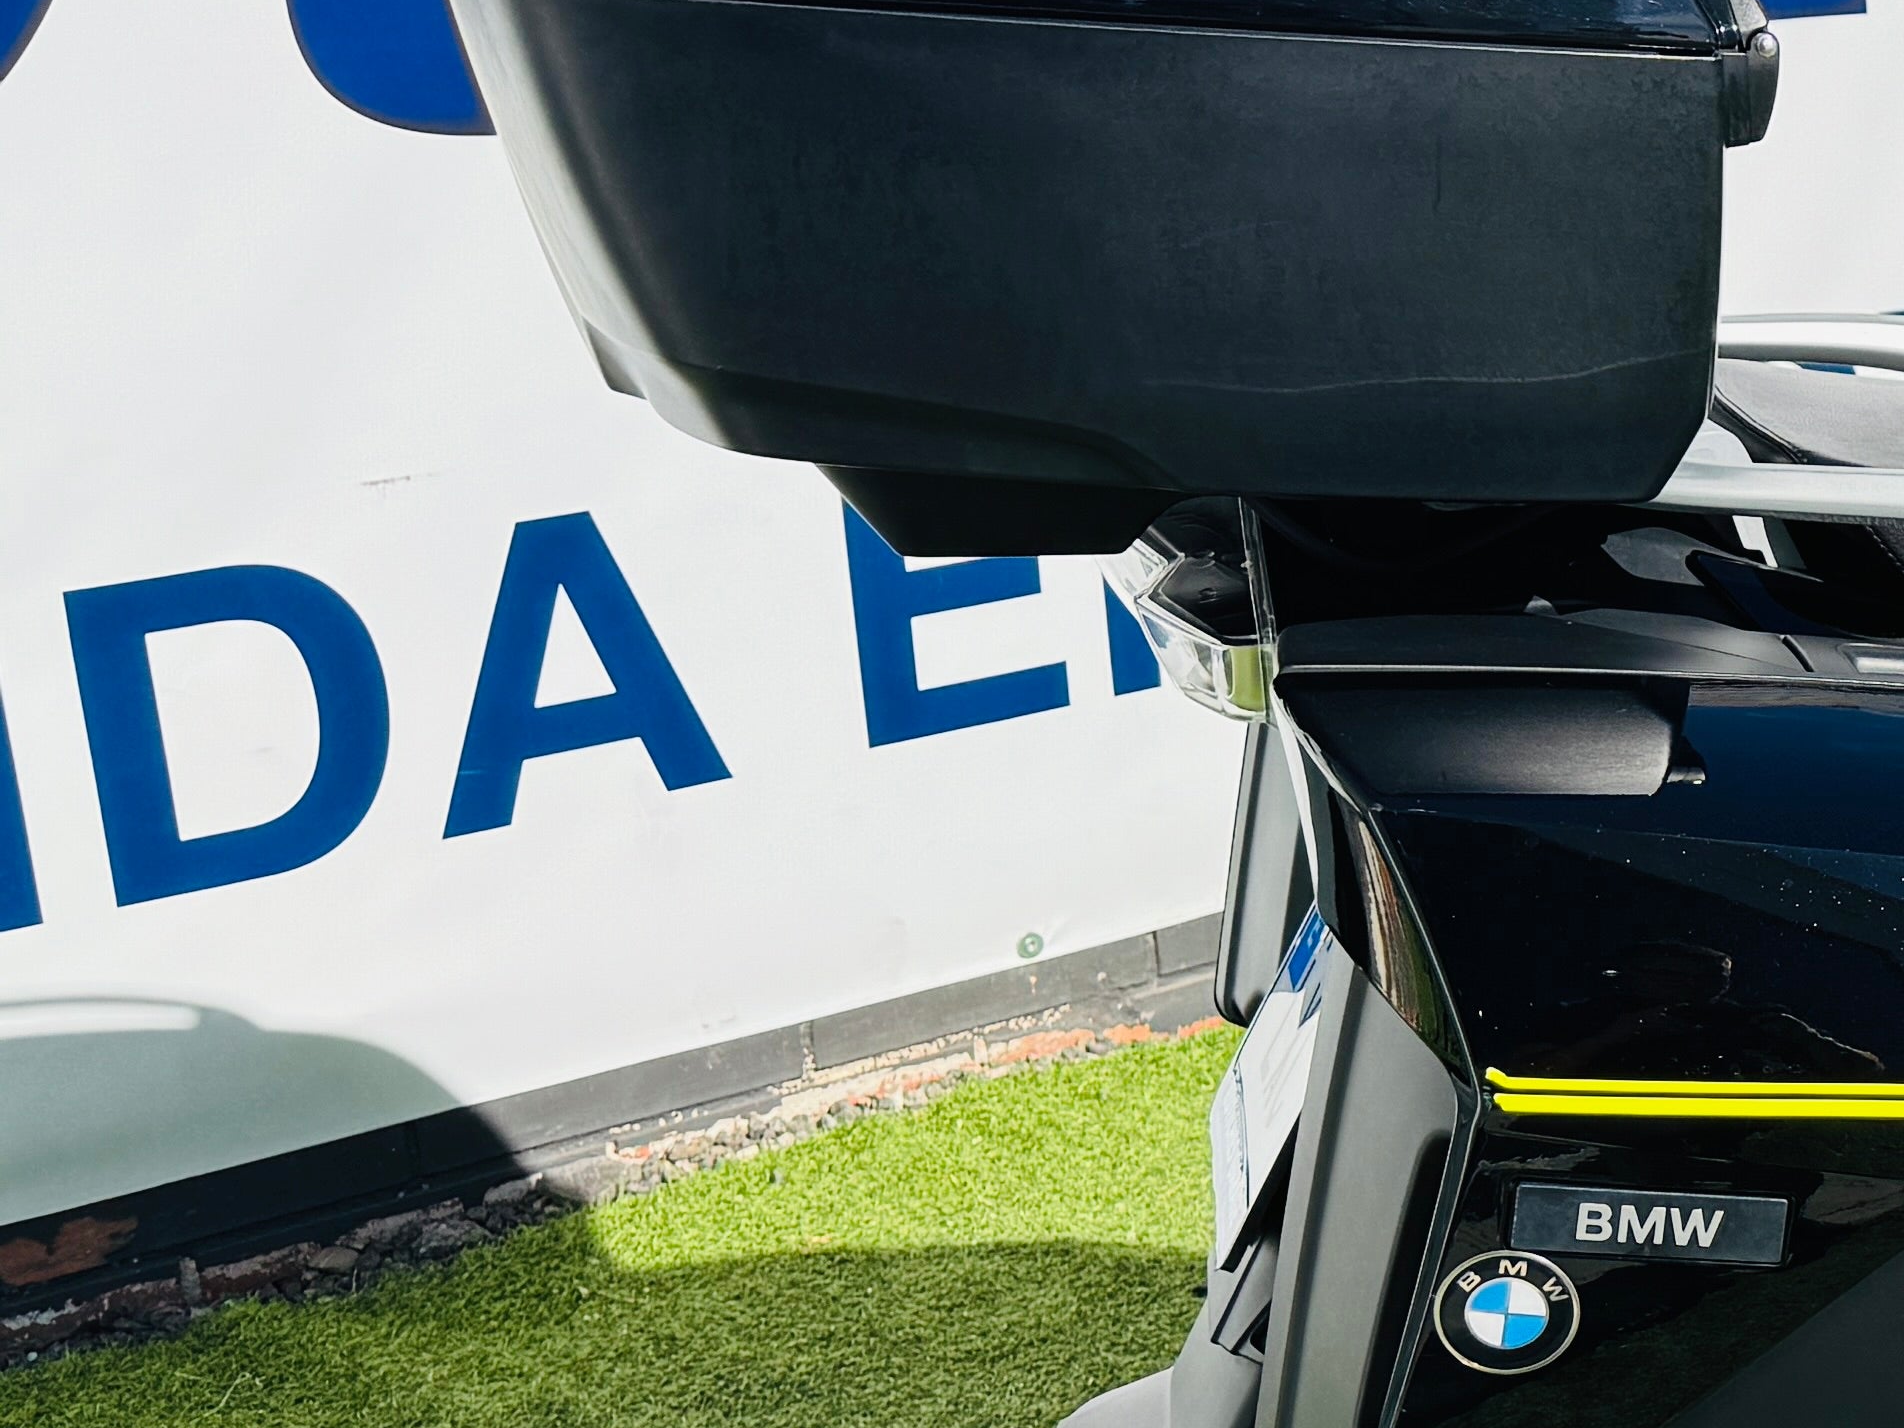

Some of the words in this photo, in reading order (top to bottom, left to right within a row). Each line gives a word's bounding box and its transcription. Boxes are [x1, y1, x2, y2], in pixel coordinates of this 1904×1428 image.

[0, 510, 734, 933] DA
[1574, 1201, 1725, 1249] BMW
[1456, 1258, 1570, 1303] BMW
